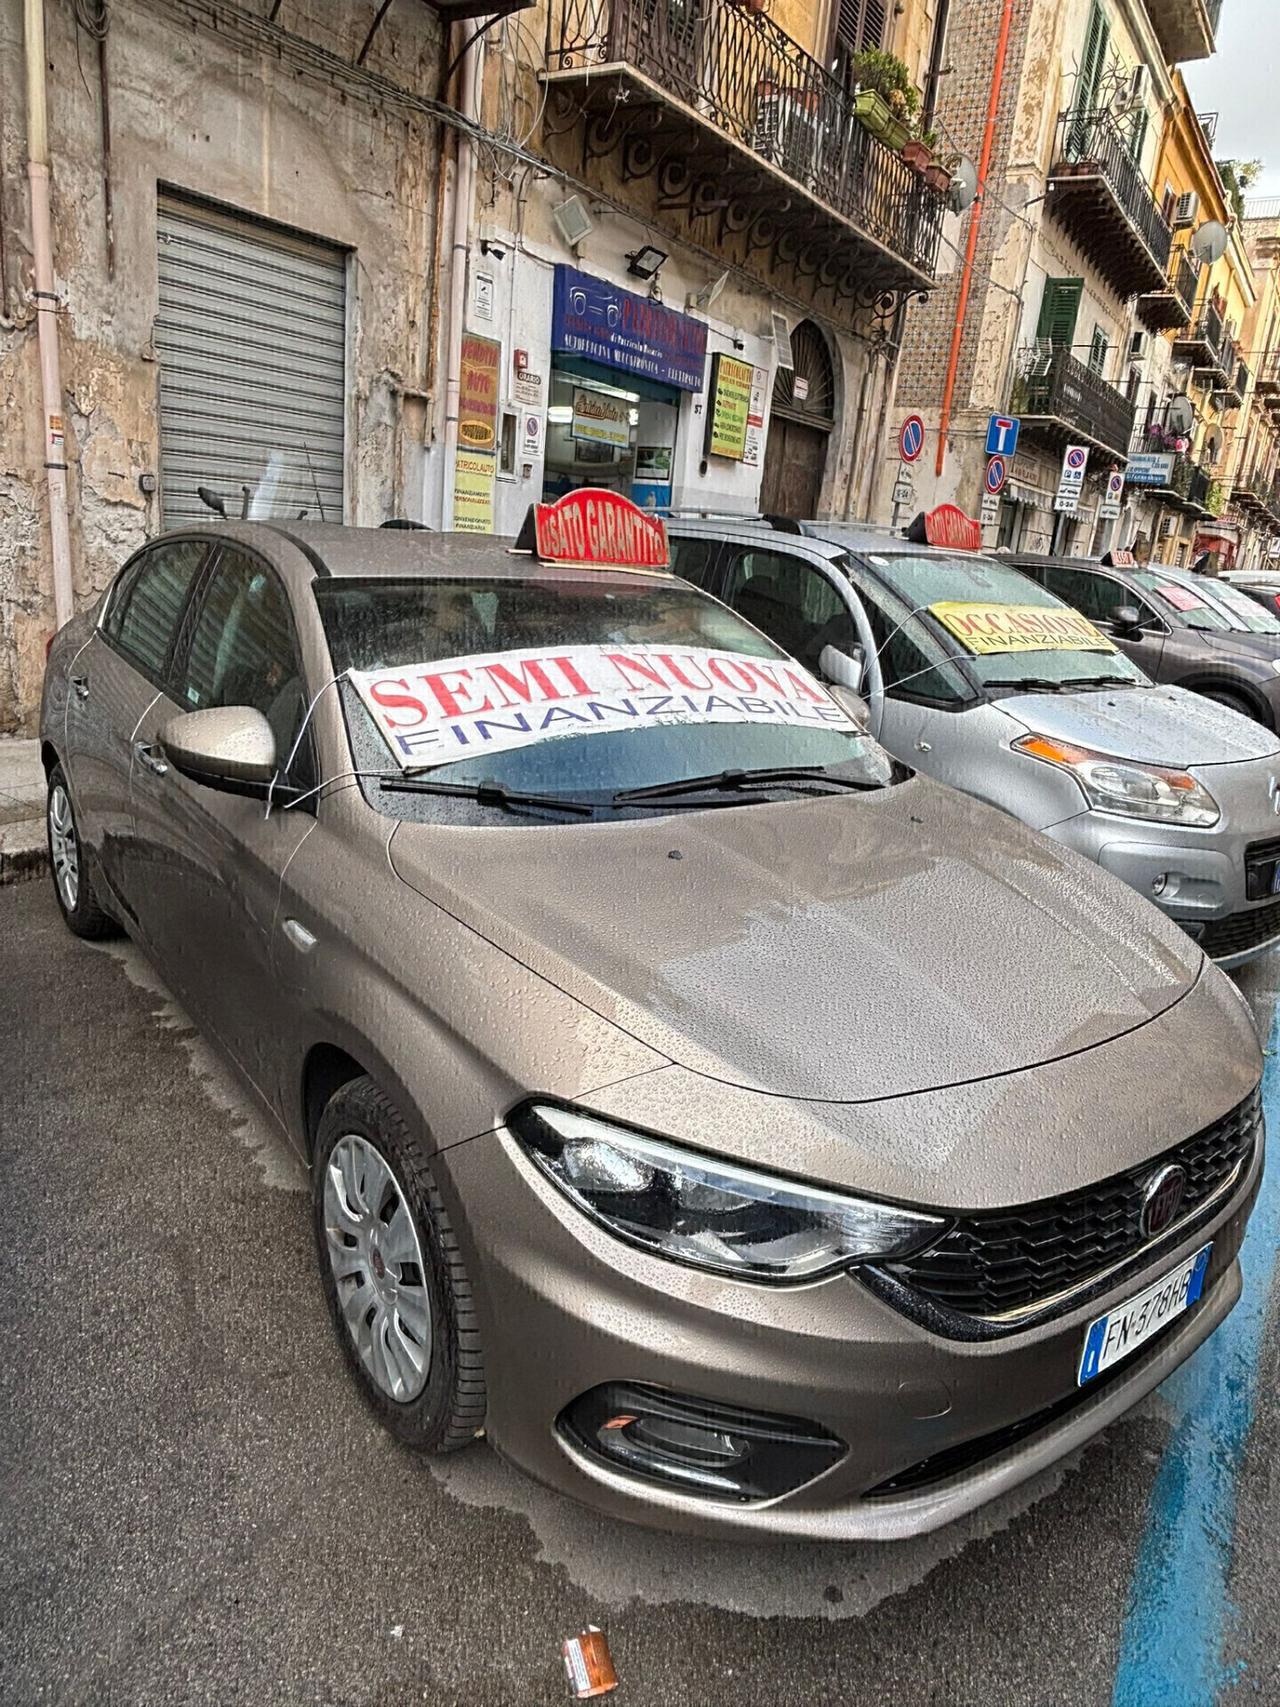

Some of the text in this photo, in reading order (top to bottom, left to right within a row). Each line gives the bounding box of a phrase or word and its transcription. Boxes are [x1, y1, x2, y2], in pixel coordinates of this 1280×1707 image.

[541, 499, 665, 563] USATO GARANTITO
[944, 612, 1102, 638] OCCASIONE
[966, 633, 1109, 647] FINANZIABILE
[369, 652, 830, 729] SEMI NUOVA
[395, 694, 849, 756] FINANZIABILE
